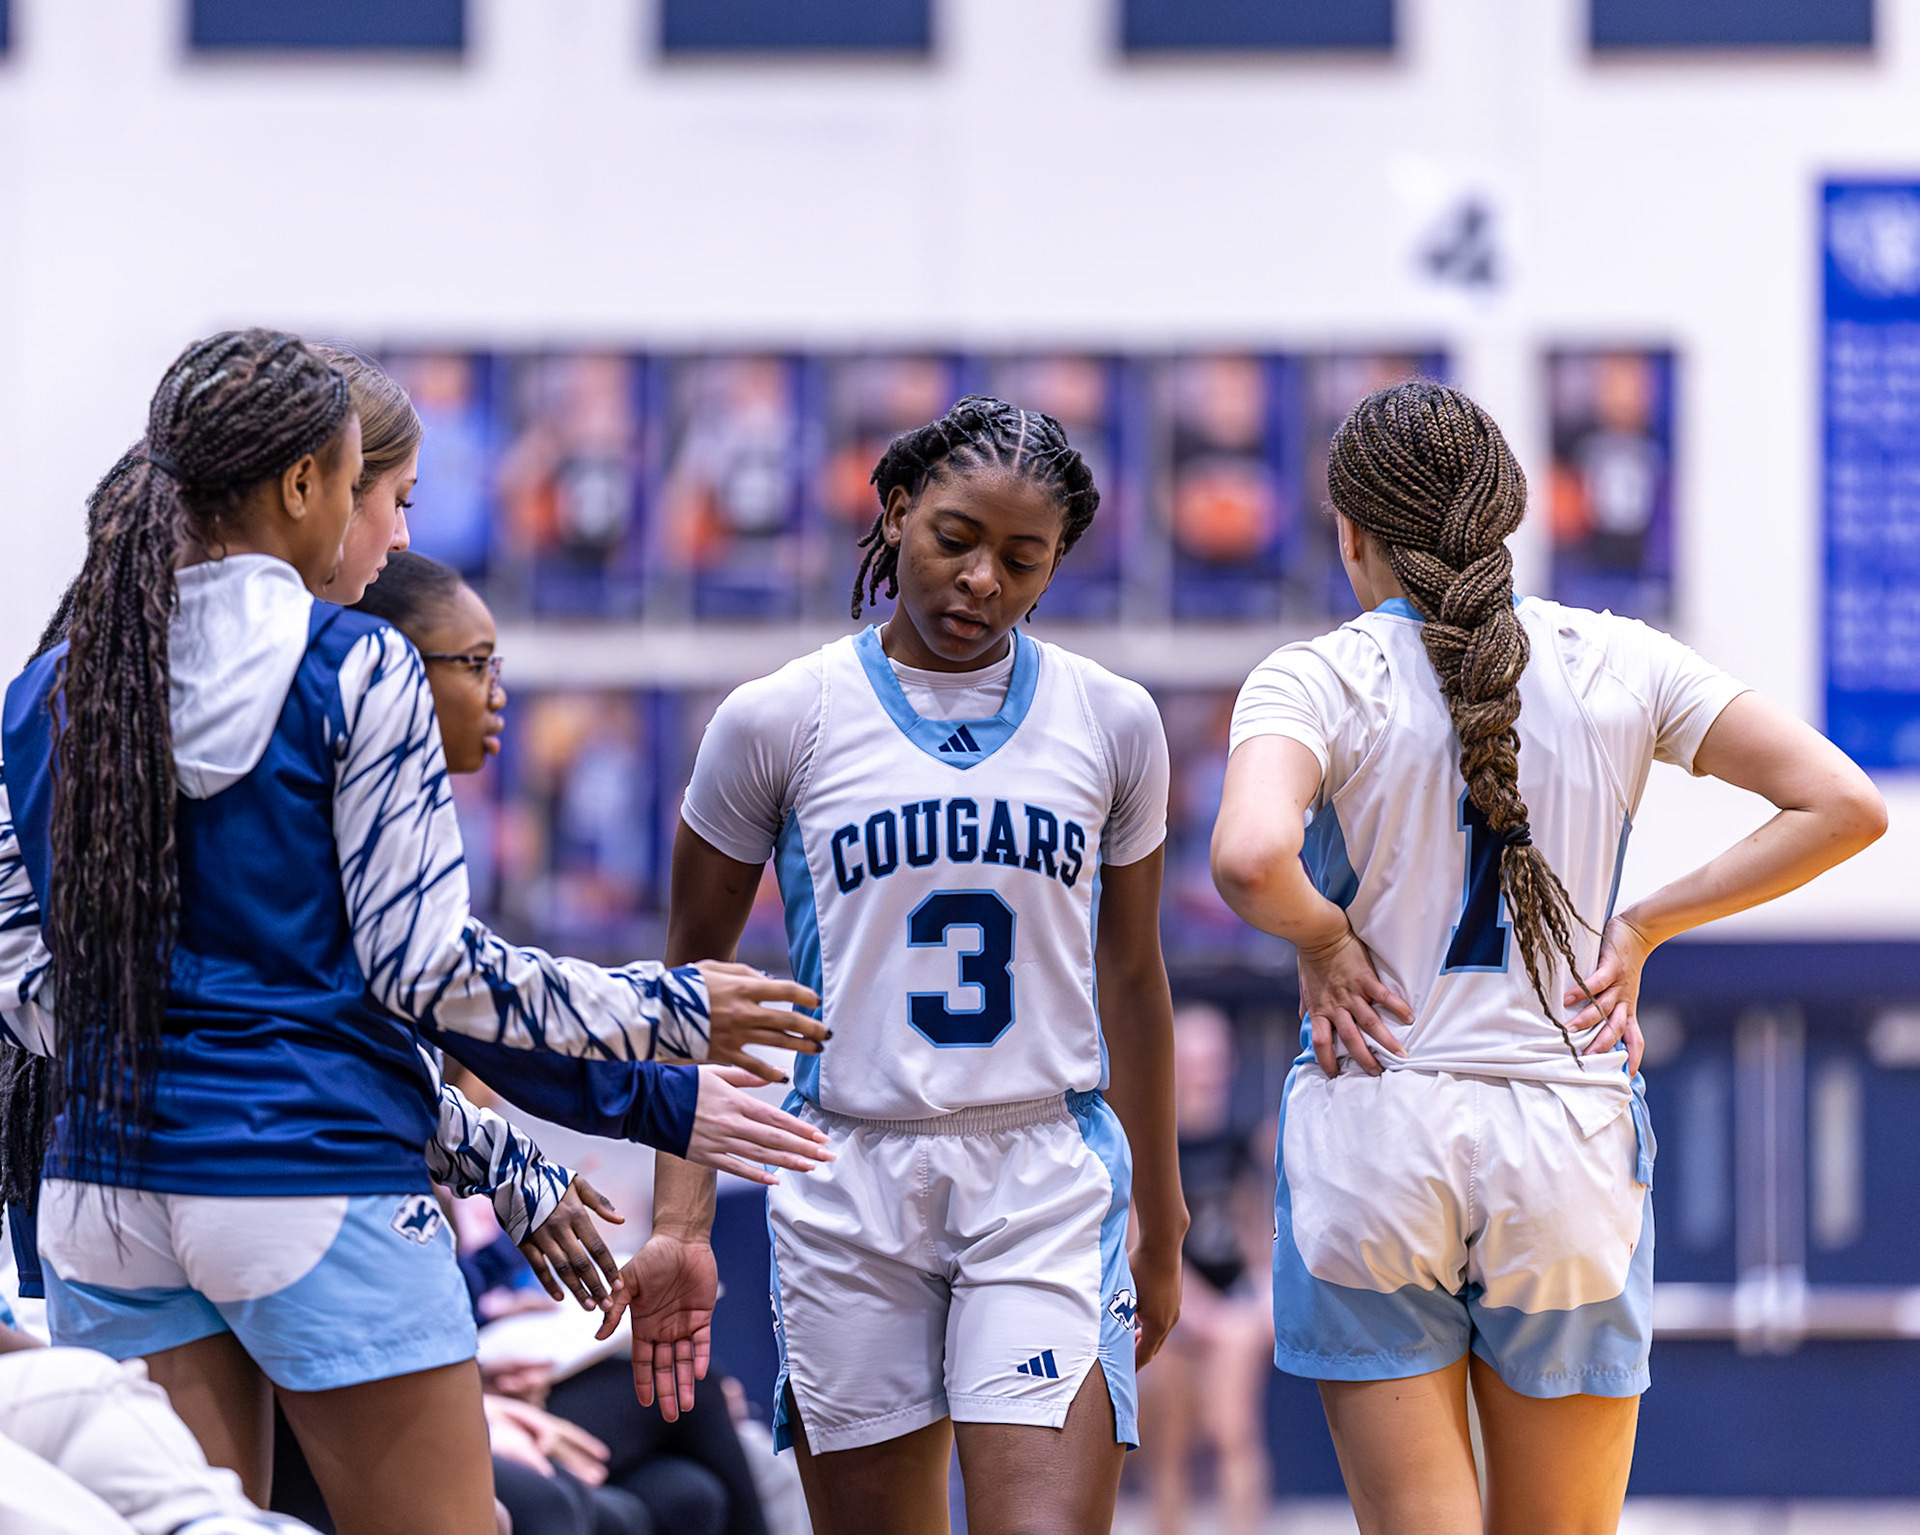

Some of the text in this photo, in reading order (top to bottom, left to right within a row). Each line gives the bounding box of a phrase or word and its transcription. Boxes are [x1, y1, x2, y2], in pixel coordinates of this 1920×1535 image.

[831, 798, 1086, 895] COUGARS
[1439, 784, 1513, 976] 1
[906, 889, 1017, 1048] 3
